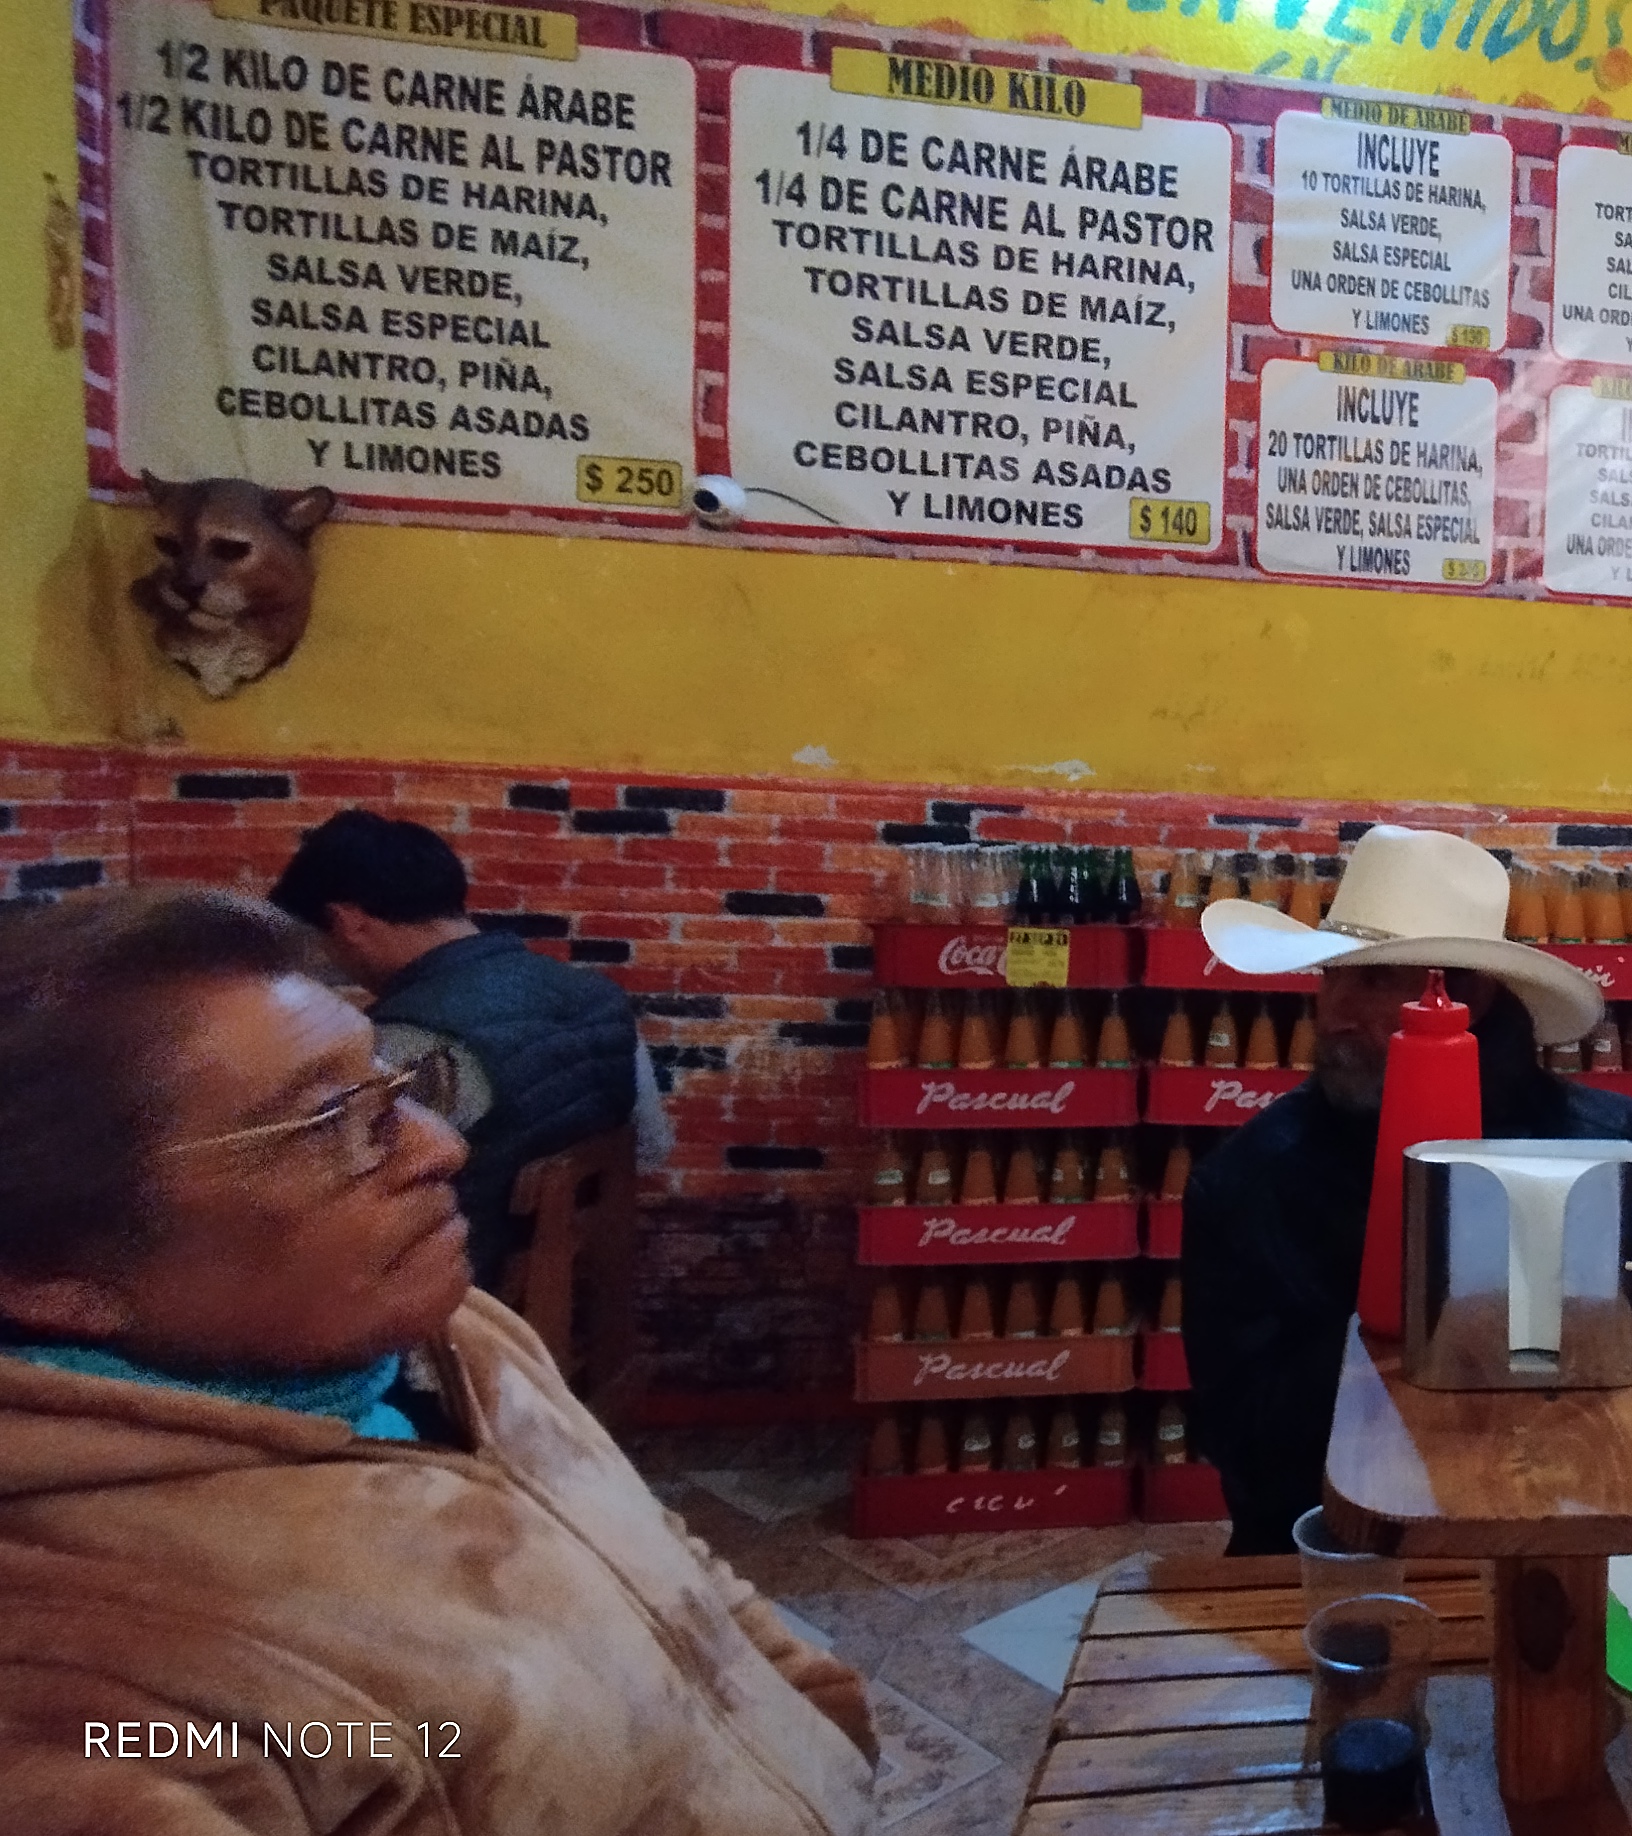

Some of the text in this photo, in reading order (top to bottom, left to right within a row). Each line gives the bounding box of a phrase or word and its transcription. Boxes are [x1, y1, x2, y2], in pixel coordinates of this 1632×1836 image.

[409, 2, 547, 48] ESPECIAL
[156, 40, 634, 130] 1/2 KILO DE CARNE ÁRABE
[888, 55, 1085, 117] MEDIO KILO
[116, 91, 671, 187] 1/2 KILO DE CARNE AL PASTOR
[797, 121, 1177, 198] 1/4 DE CARNE ÁRABE
[1358, 132, 1439, 177] INCLUYE
[185, 148, 607, 226] TORTILLAS DE HARINA,
[755, 169, 1213, 252] 1/4 DE CARNE AL PASTOR
[1302, 170, 1486, 211] 10 TORTILLAS DE HARINA,
[217, 200, 589, 270] TORTILLAS DE MAÍZ,
[1341, 208, 1441, 241] SALSA VERDE,
[267, 252, 522, 307] SALSA VERDE,
[772, 219, 1194, 293] TORTILLAS DE HARINA,
[804, 266, 1175, 333] TORTILLAS DE MAÍZ,
[1292, 270, 1490, 309] UNA ORDEN DE CEBOLLITAS
[251, 297, 550, 348] SALSA ESPECIAL
[852, 316, 1110, 370] SALSA VERDE,
[252, 344, 552, 400] CILANTRO, PIÑA,
[834, 357, 1137, 408] SALSA ESPECIAL
[215, 385, 589, 441] CEBOLLITAS ASADAS
[835, 401, 1135, 455] CILANTRO, PIÑA,
[1337, 386, 1419, 427] INCLUYE
[307, 439, 501, 479] Y LIMONES
[586, 463, 674, 496] $ 250
[794, 441, 1171, 494] CEBOLLITAS ASADAS
[888, 491, 1083, 528] Y LIMONES
[1140, 505, 1197, 537] $ 140
[1266, 503, 1480, 544] SALSA VERDE, SALSA ESPECIAL
[915, 1079, 1076, 1115] Pascual
[917, 1215, 1077, 1247] Pascual
[913, 1350, 1071, 1386] Pascual
